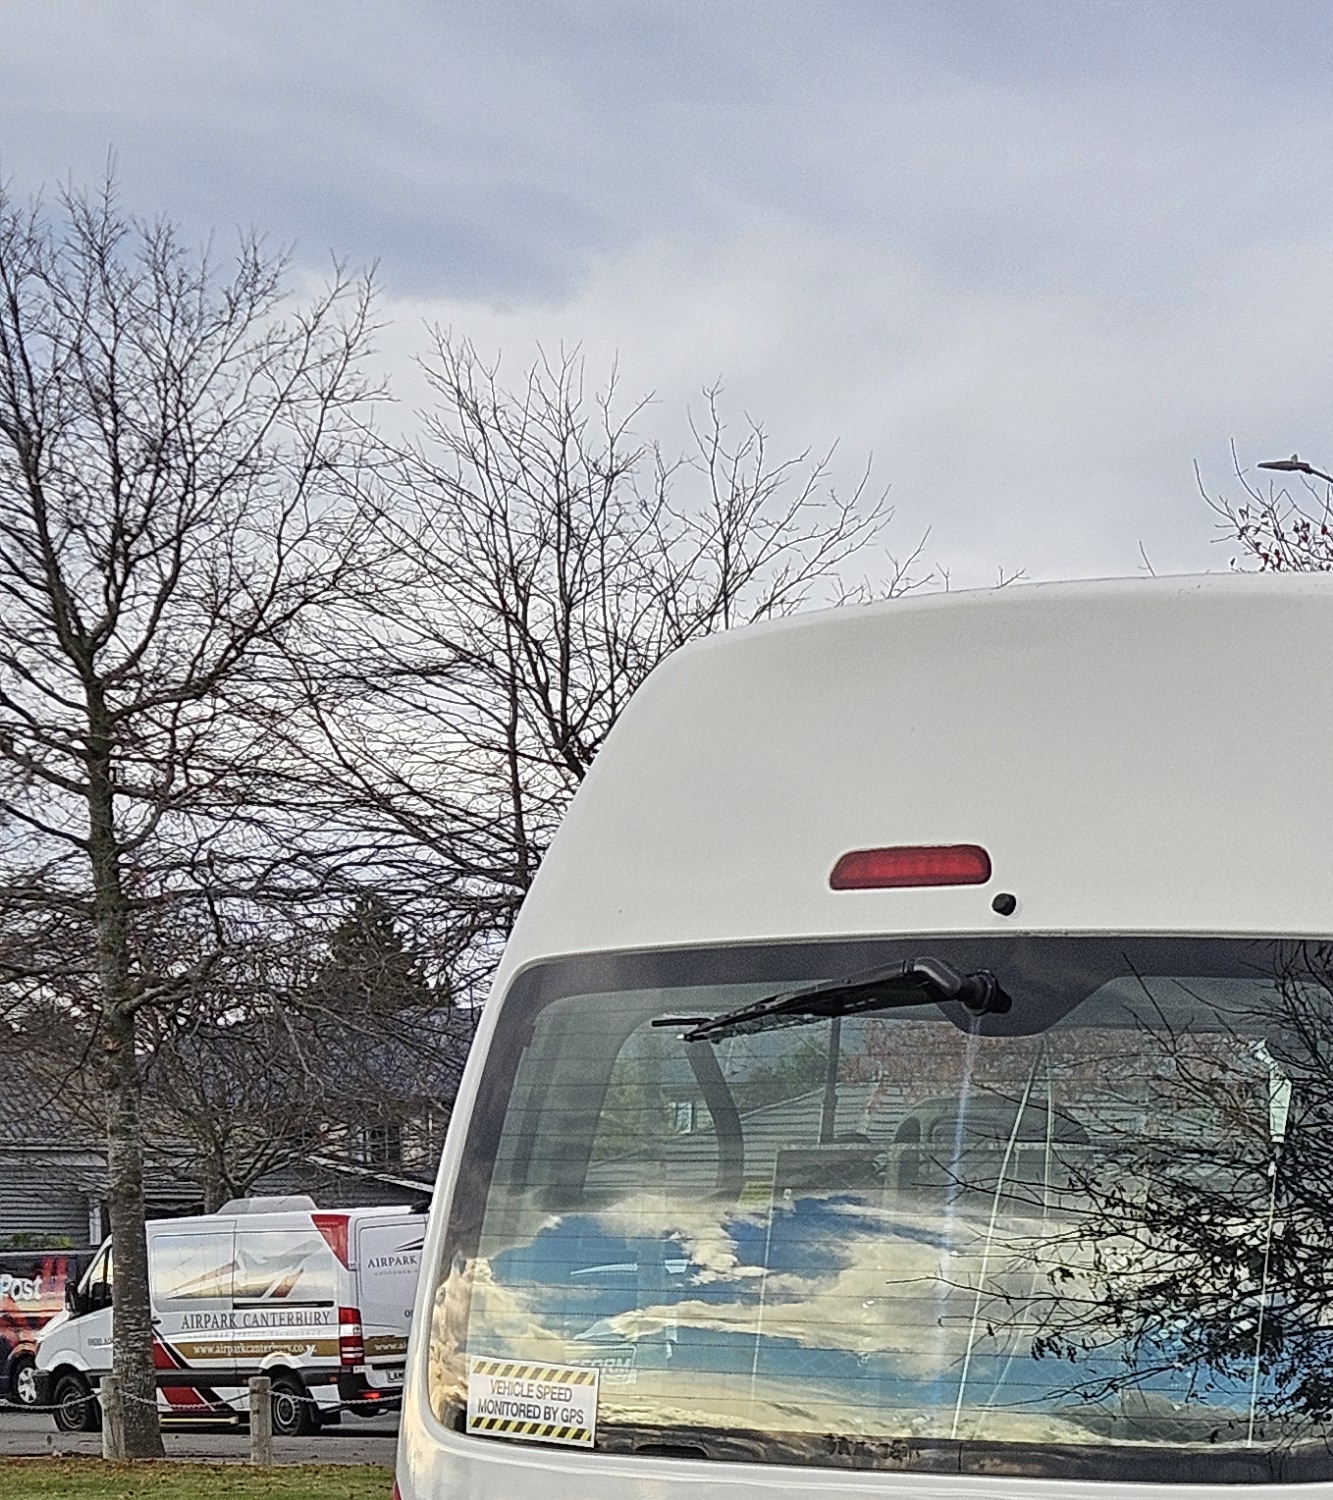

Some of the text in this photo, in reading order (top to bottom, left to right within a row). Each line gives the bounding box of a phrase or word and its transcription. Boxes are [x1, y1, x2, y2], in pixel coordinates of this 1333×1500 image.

[368, 1255, 418, 1268] AIRPARK
[181, 1311, 331, 1330] AIRPARK CANTERBURY
[490, 1379, 573, 1402] VEHICLE SPEED
[478, 1398, 584, 1425] MONITORED BY GPS
